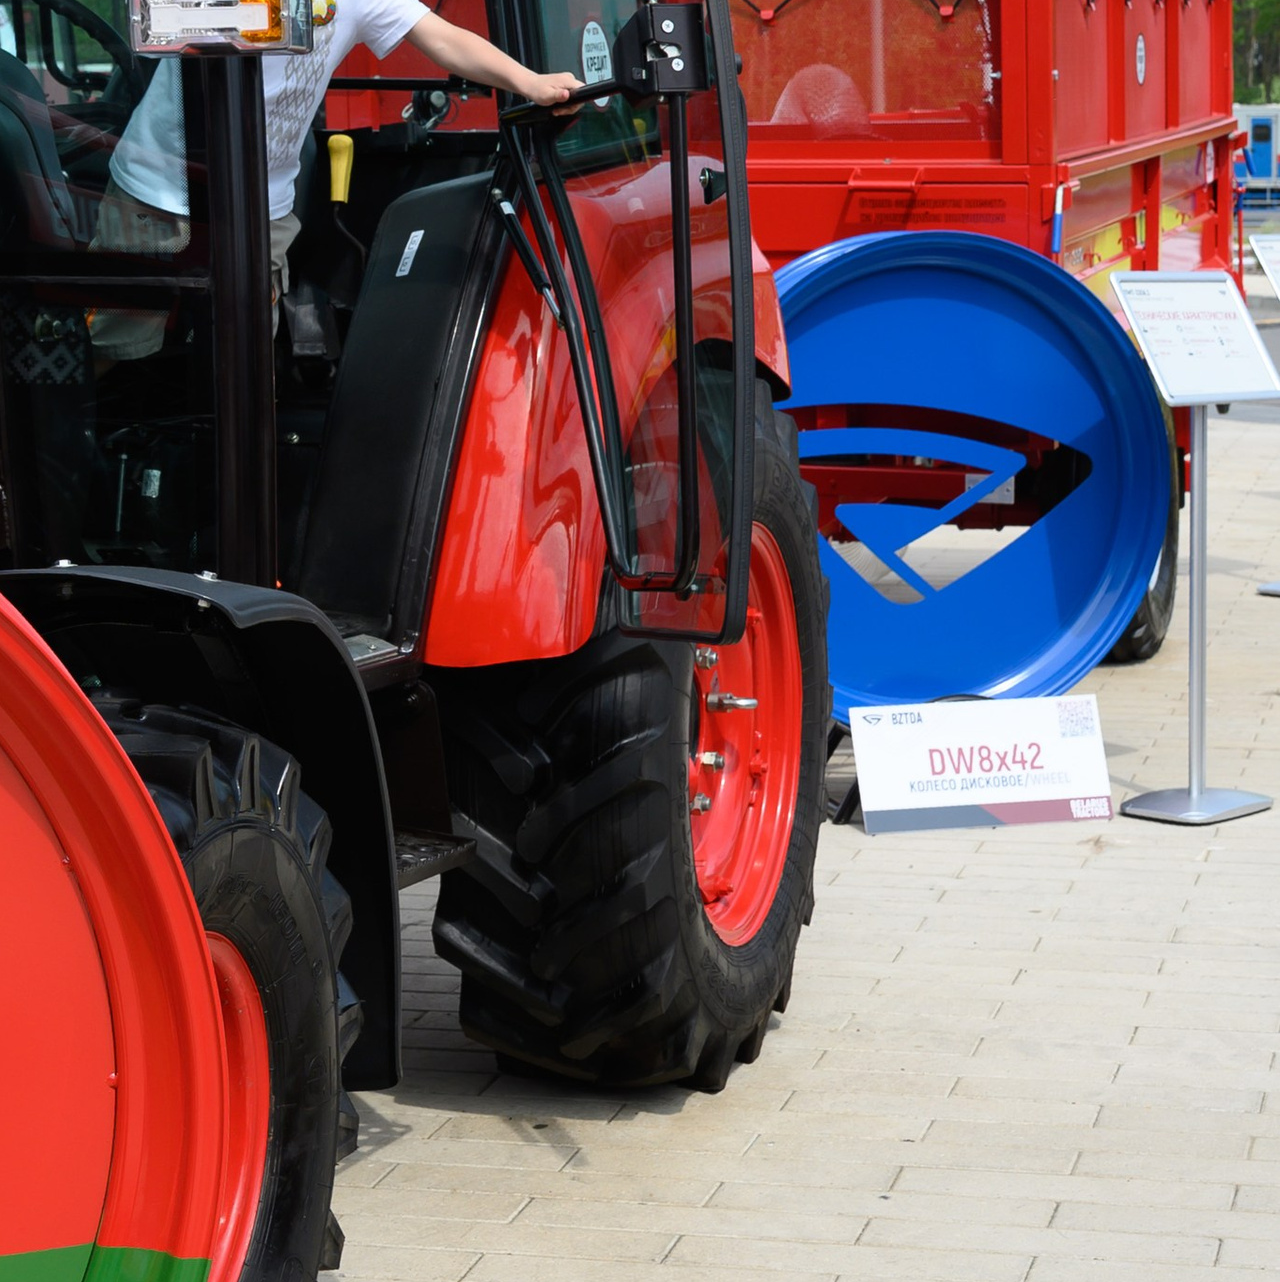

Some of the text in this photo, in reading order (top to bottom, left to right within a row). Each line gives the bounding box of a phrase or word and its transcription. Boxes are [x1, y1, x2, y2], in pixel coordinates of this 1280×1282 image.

[891, 711, 923, 725] BZTDA
[928, 742, 1045, 776] DW8x42
[909, 780, 957, 793] КОЛЕСО
